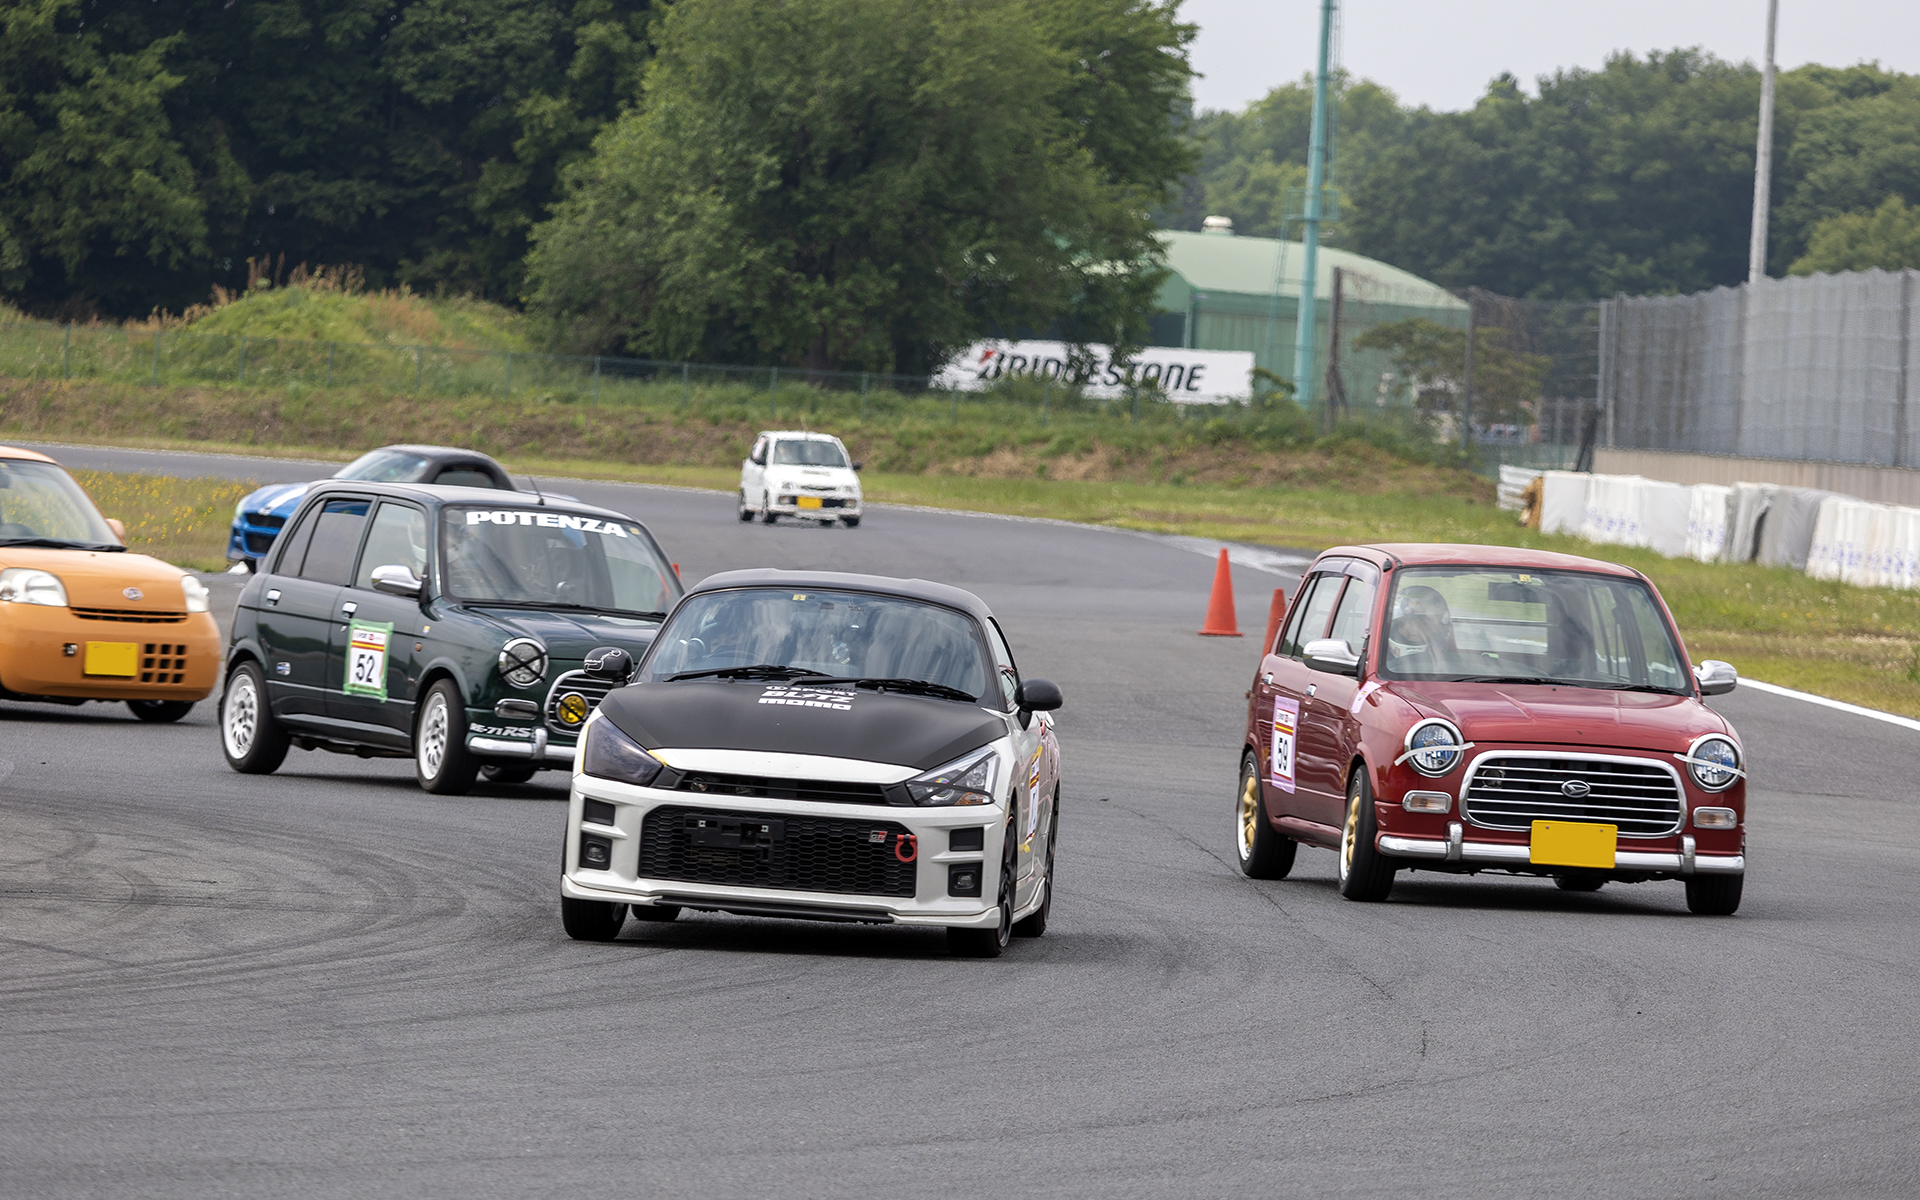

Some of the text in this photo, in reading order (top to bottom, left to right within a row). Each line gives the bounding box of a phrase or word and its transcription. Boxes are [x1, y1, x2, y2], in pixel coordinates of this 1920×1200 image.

[466, 511, 627, 537] POTENZA
[355, 654, 375, 683] 52
[761, 691, 854, 703] BLITZ
[1278, 737, 1288, 771] 59
